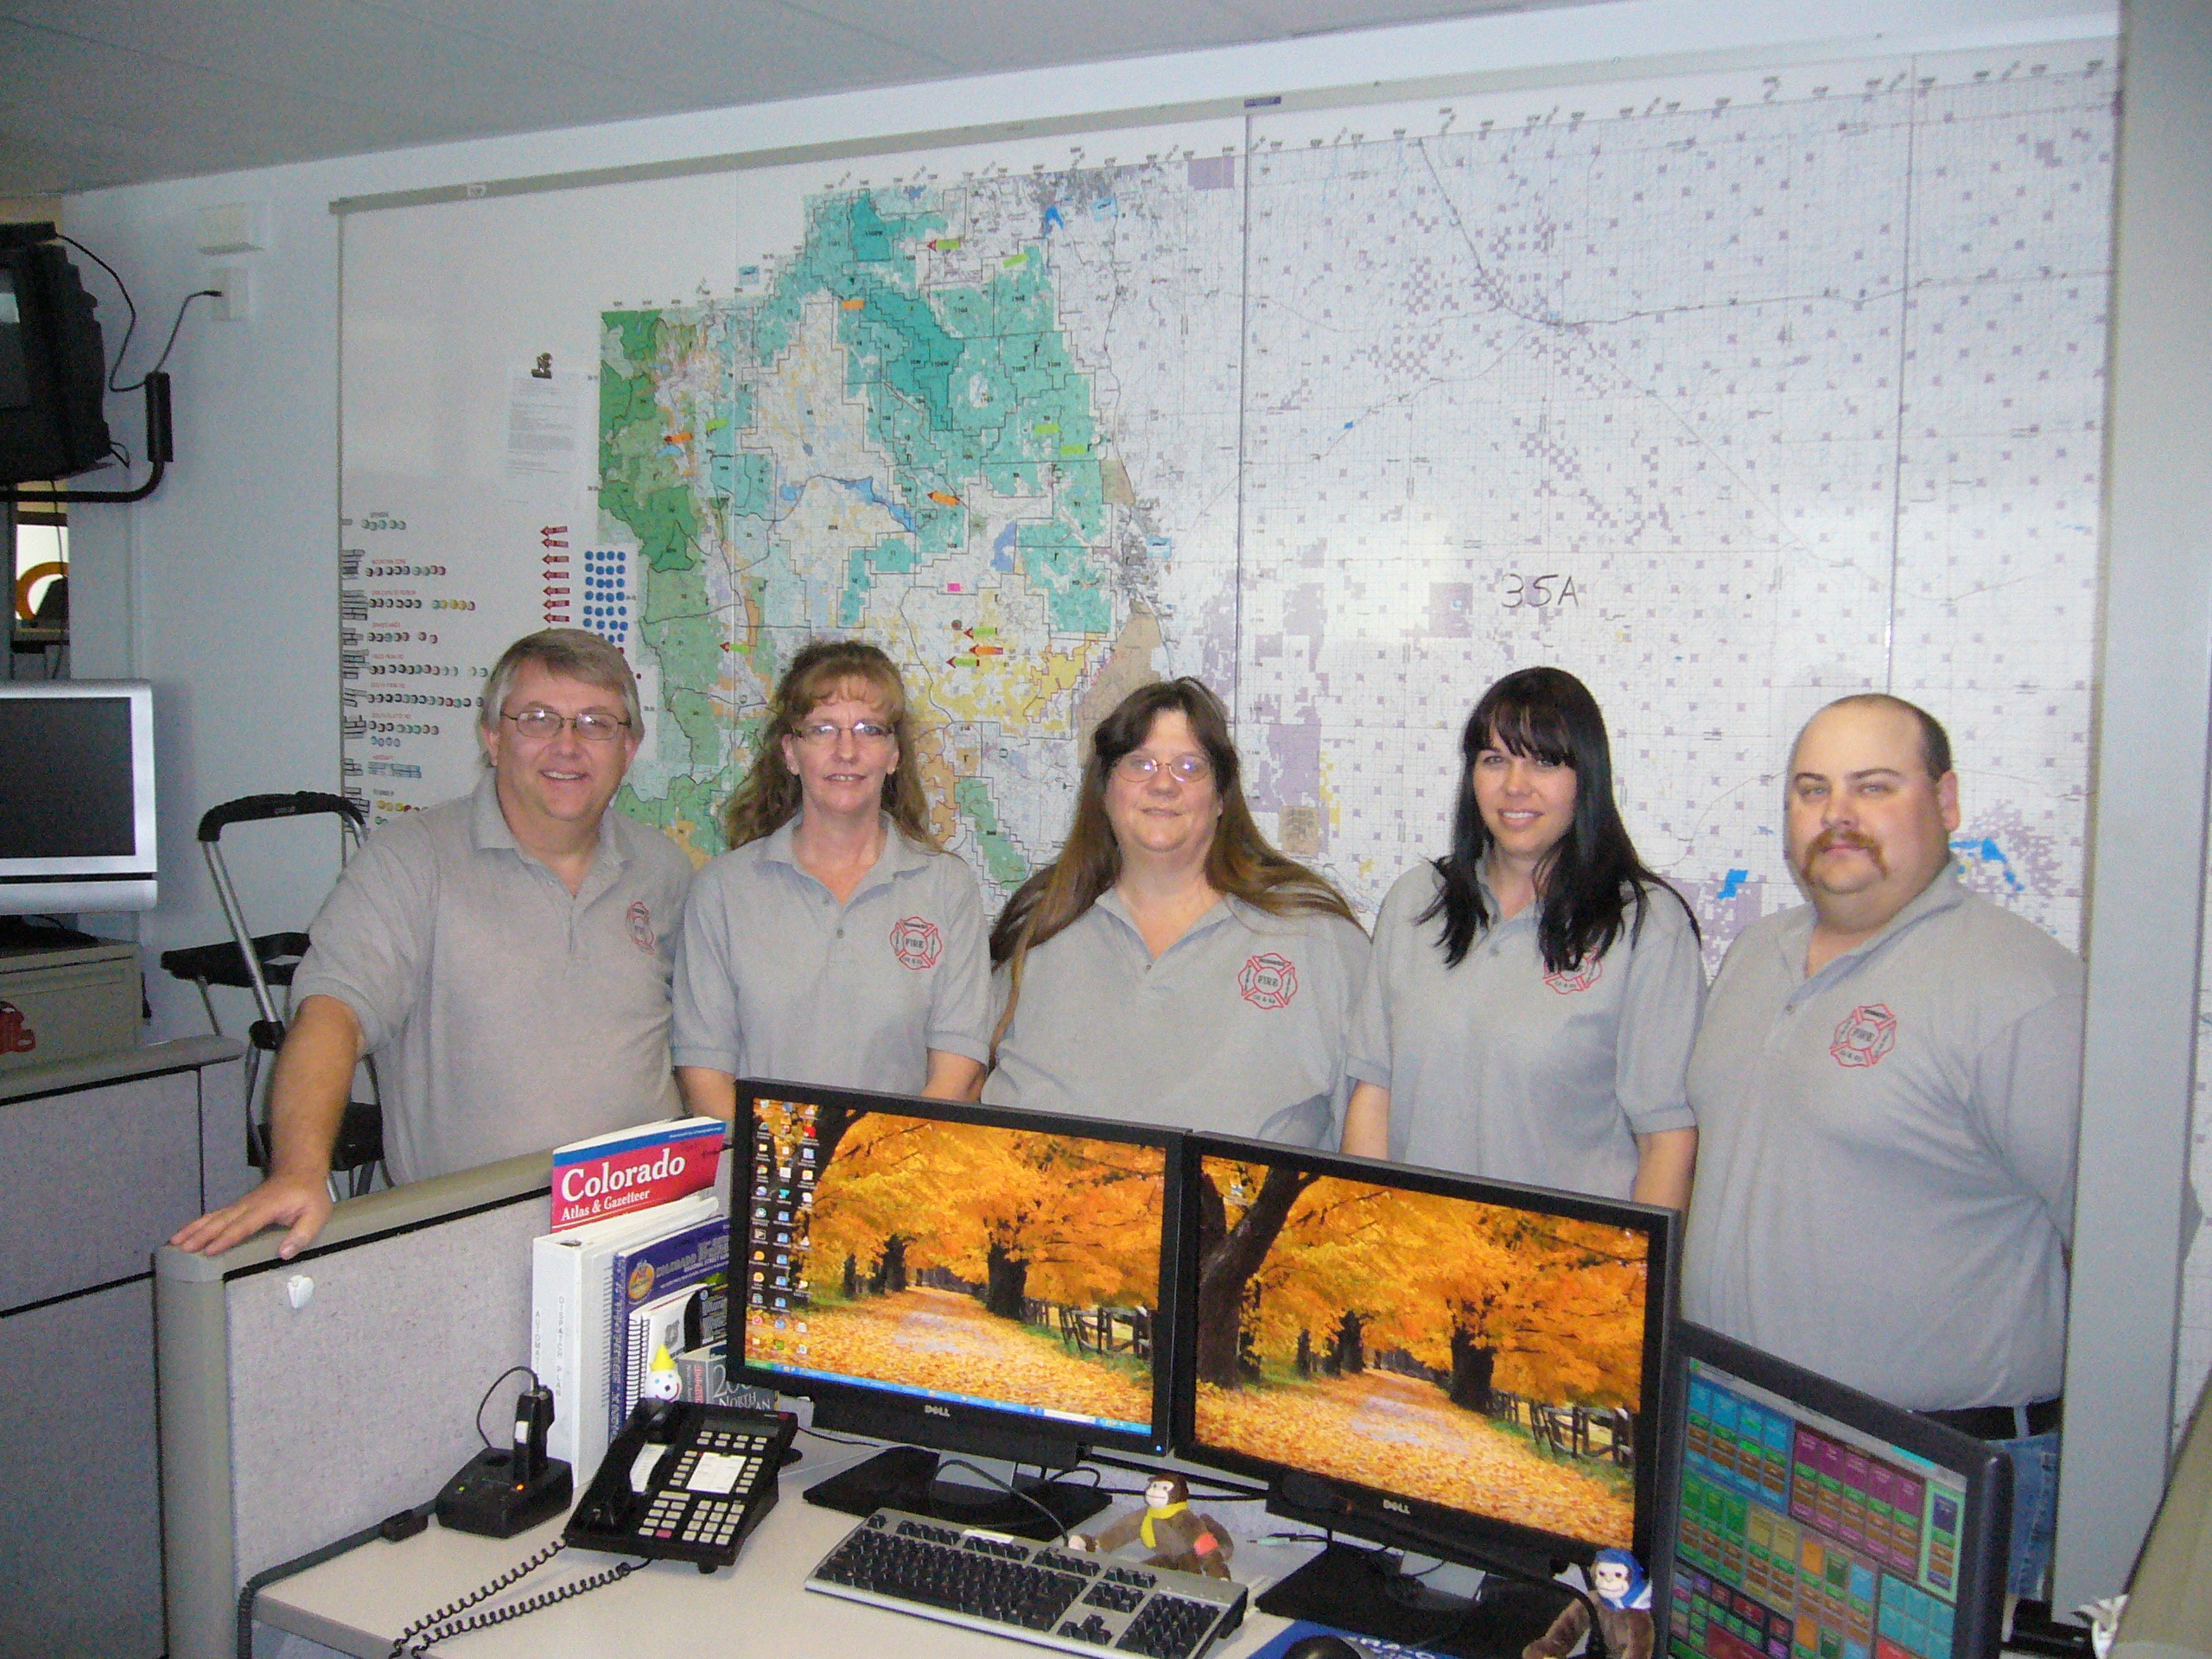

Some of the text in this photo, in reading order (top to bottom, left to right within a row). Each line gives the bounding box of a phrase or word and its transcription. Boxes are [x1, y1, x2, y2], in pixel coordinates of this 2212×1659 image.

[1501, 573, 1580, 607] 35A
[1257, 974, 1279, 988] FIRE
[561, 1147, 686, 1202] Colorado
[562, 1189, 651, 1222] Atlas & Gazetteer
[556, 1295, 565, 1358] DISPATCH
[924, 1404, 951, 1418] DELL
[1382, 1498, 1411, 1515] DELL
